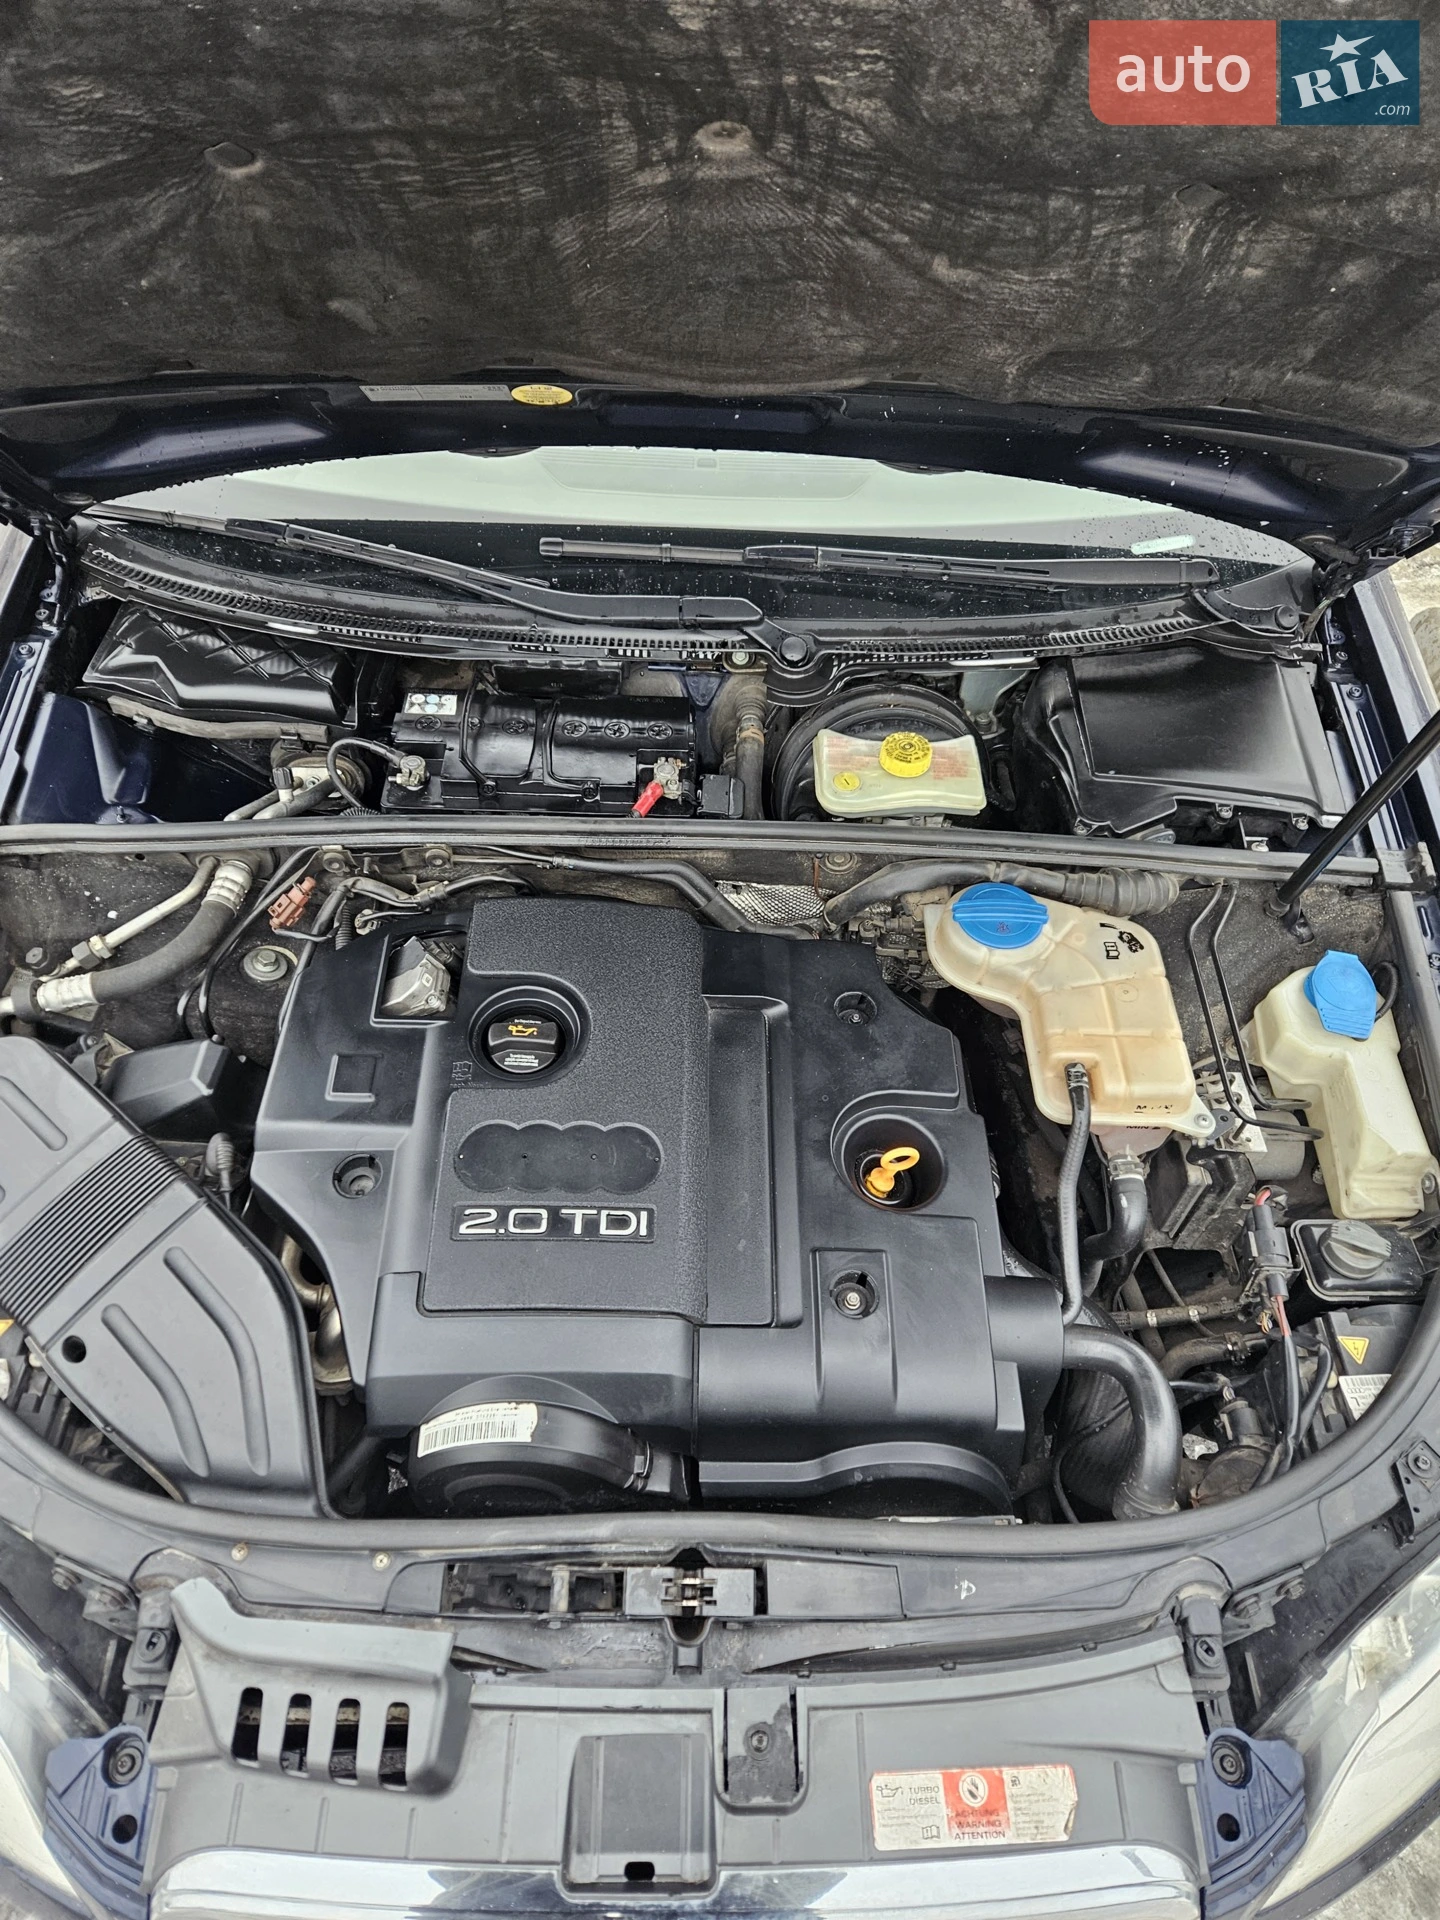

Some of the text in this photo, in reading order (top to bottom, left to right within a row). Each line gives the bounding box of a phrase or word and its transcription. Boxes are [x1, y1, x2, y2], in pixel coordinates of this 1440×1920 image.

[458, 1207, 649, 1238] 2.0 TDI
[908, 1785, 940, 1795] TURBO
[909, 1796, 941, 1806] DIESEL
[954, 1808, 1000, 1818] ACHTUNG
[955, 1819, 1002, 1829] WARNING
[954, 1830, 1006, 1841] ATTENTION
